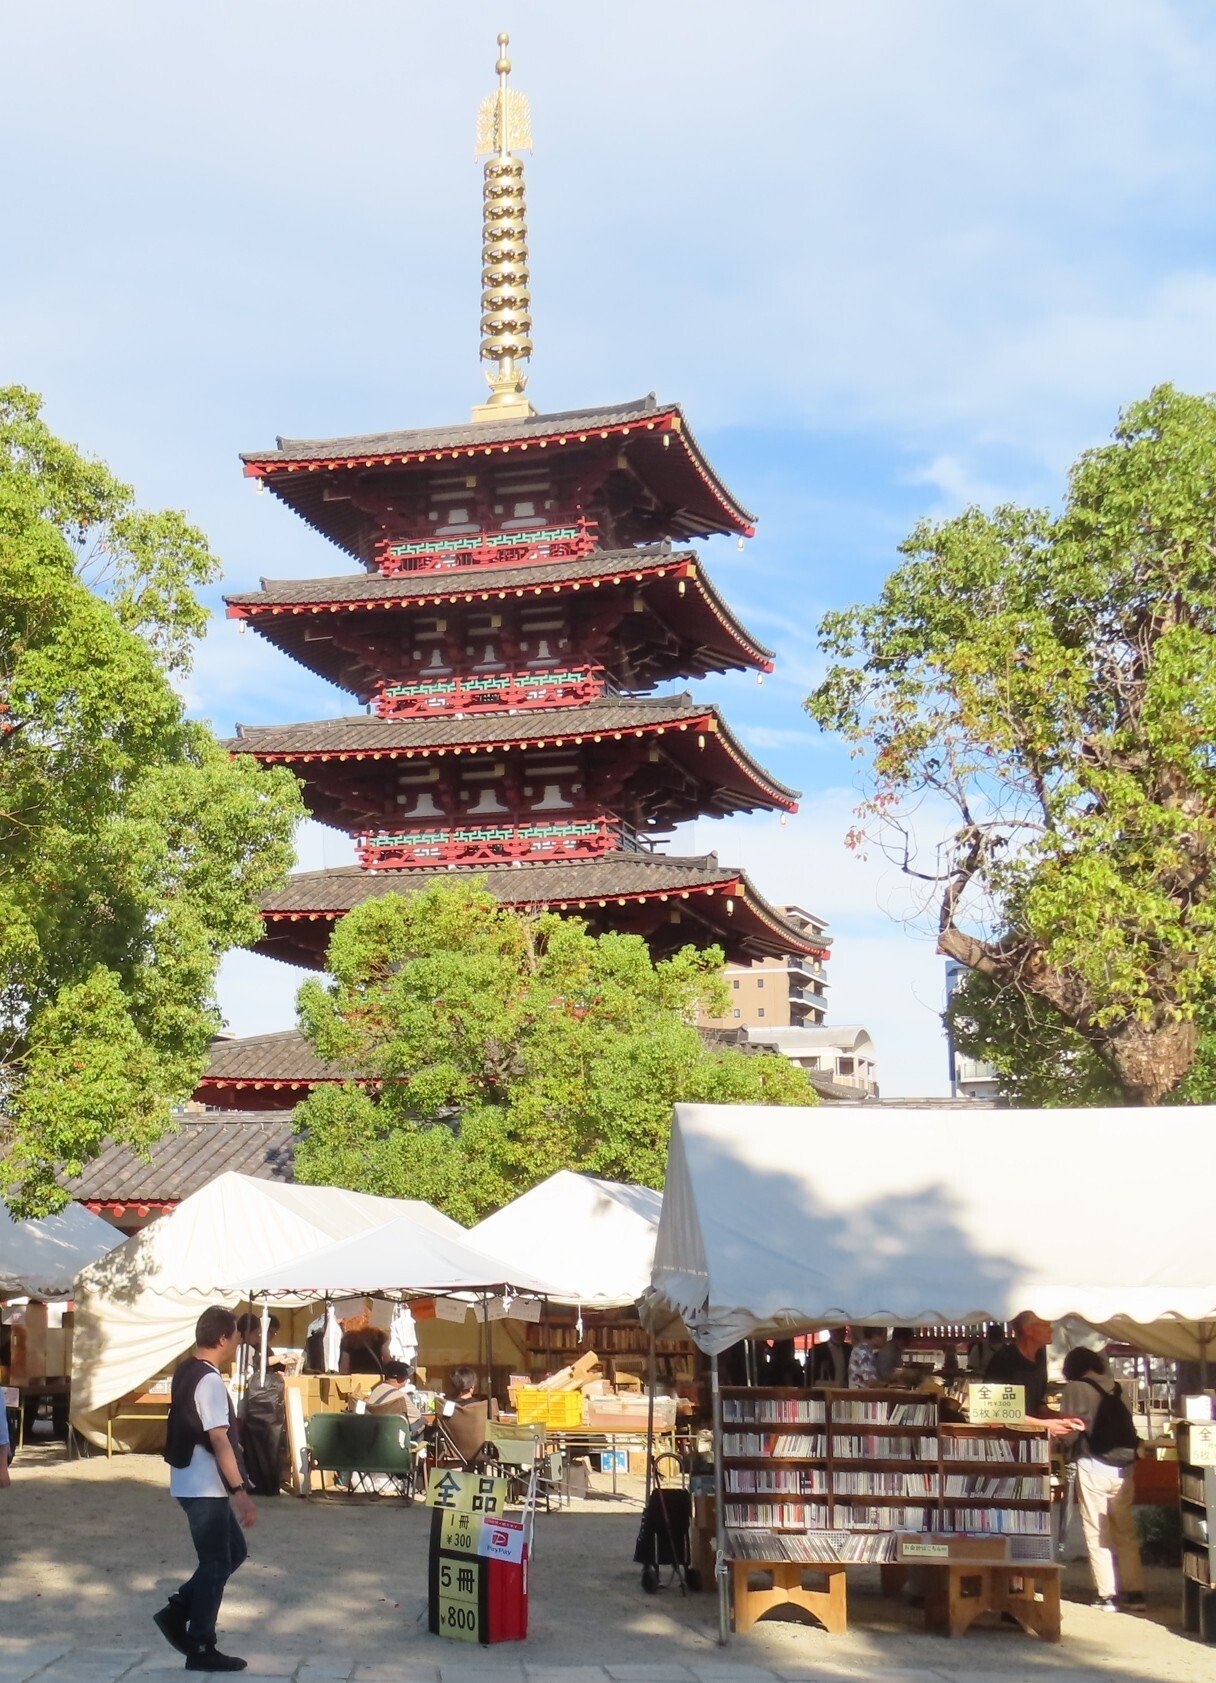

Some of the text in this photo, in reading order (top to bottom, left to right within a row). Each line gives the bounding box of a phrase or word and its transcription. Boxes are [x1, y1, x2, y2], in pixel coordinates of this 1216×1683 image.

[978, 1386, 1016, 1400] 全品
[434, 1471, 497, 1513] 全品
[451, 1514, 469, 1530] 1冊
[446, 1533, 472, 1548] ¥300
[487, 1545, 512, 1555] PayPay
[441, 1565, 475, 1594] 5冊
[441, 1606, 476, 1631] ¥800
